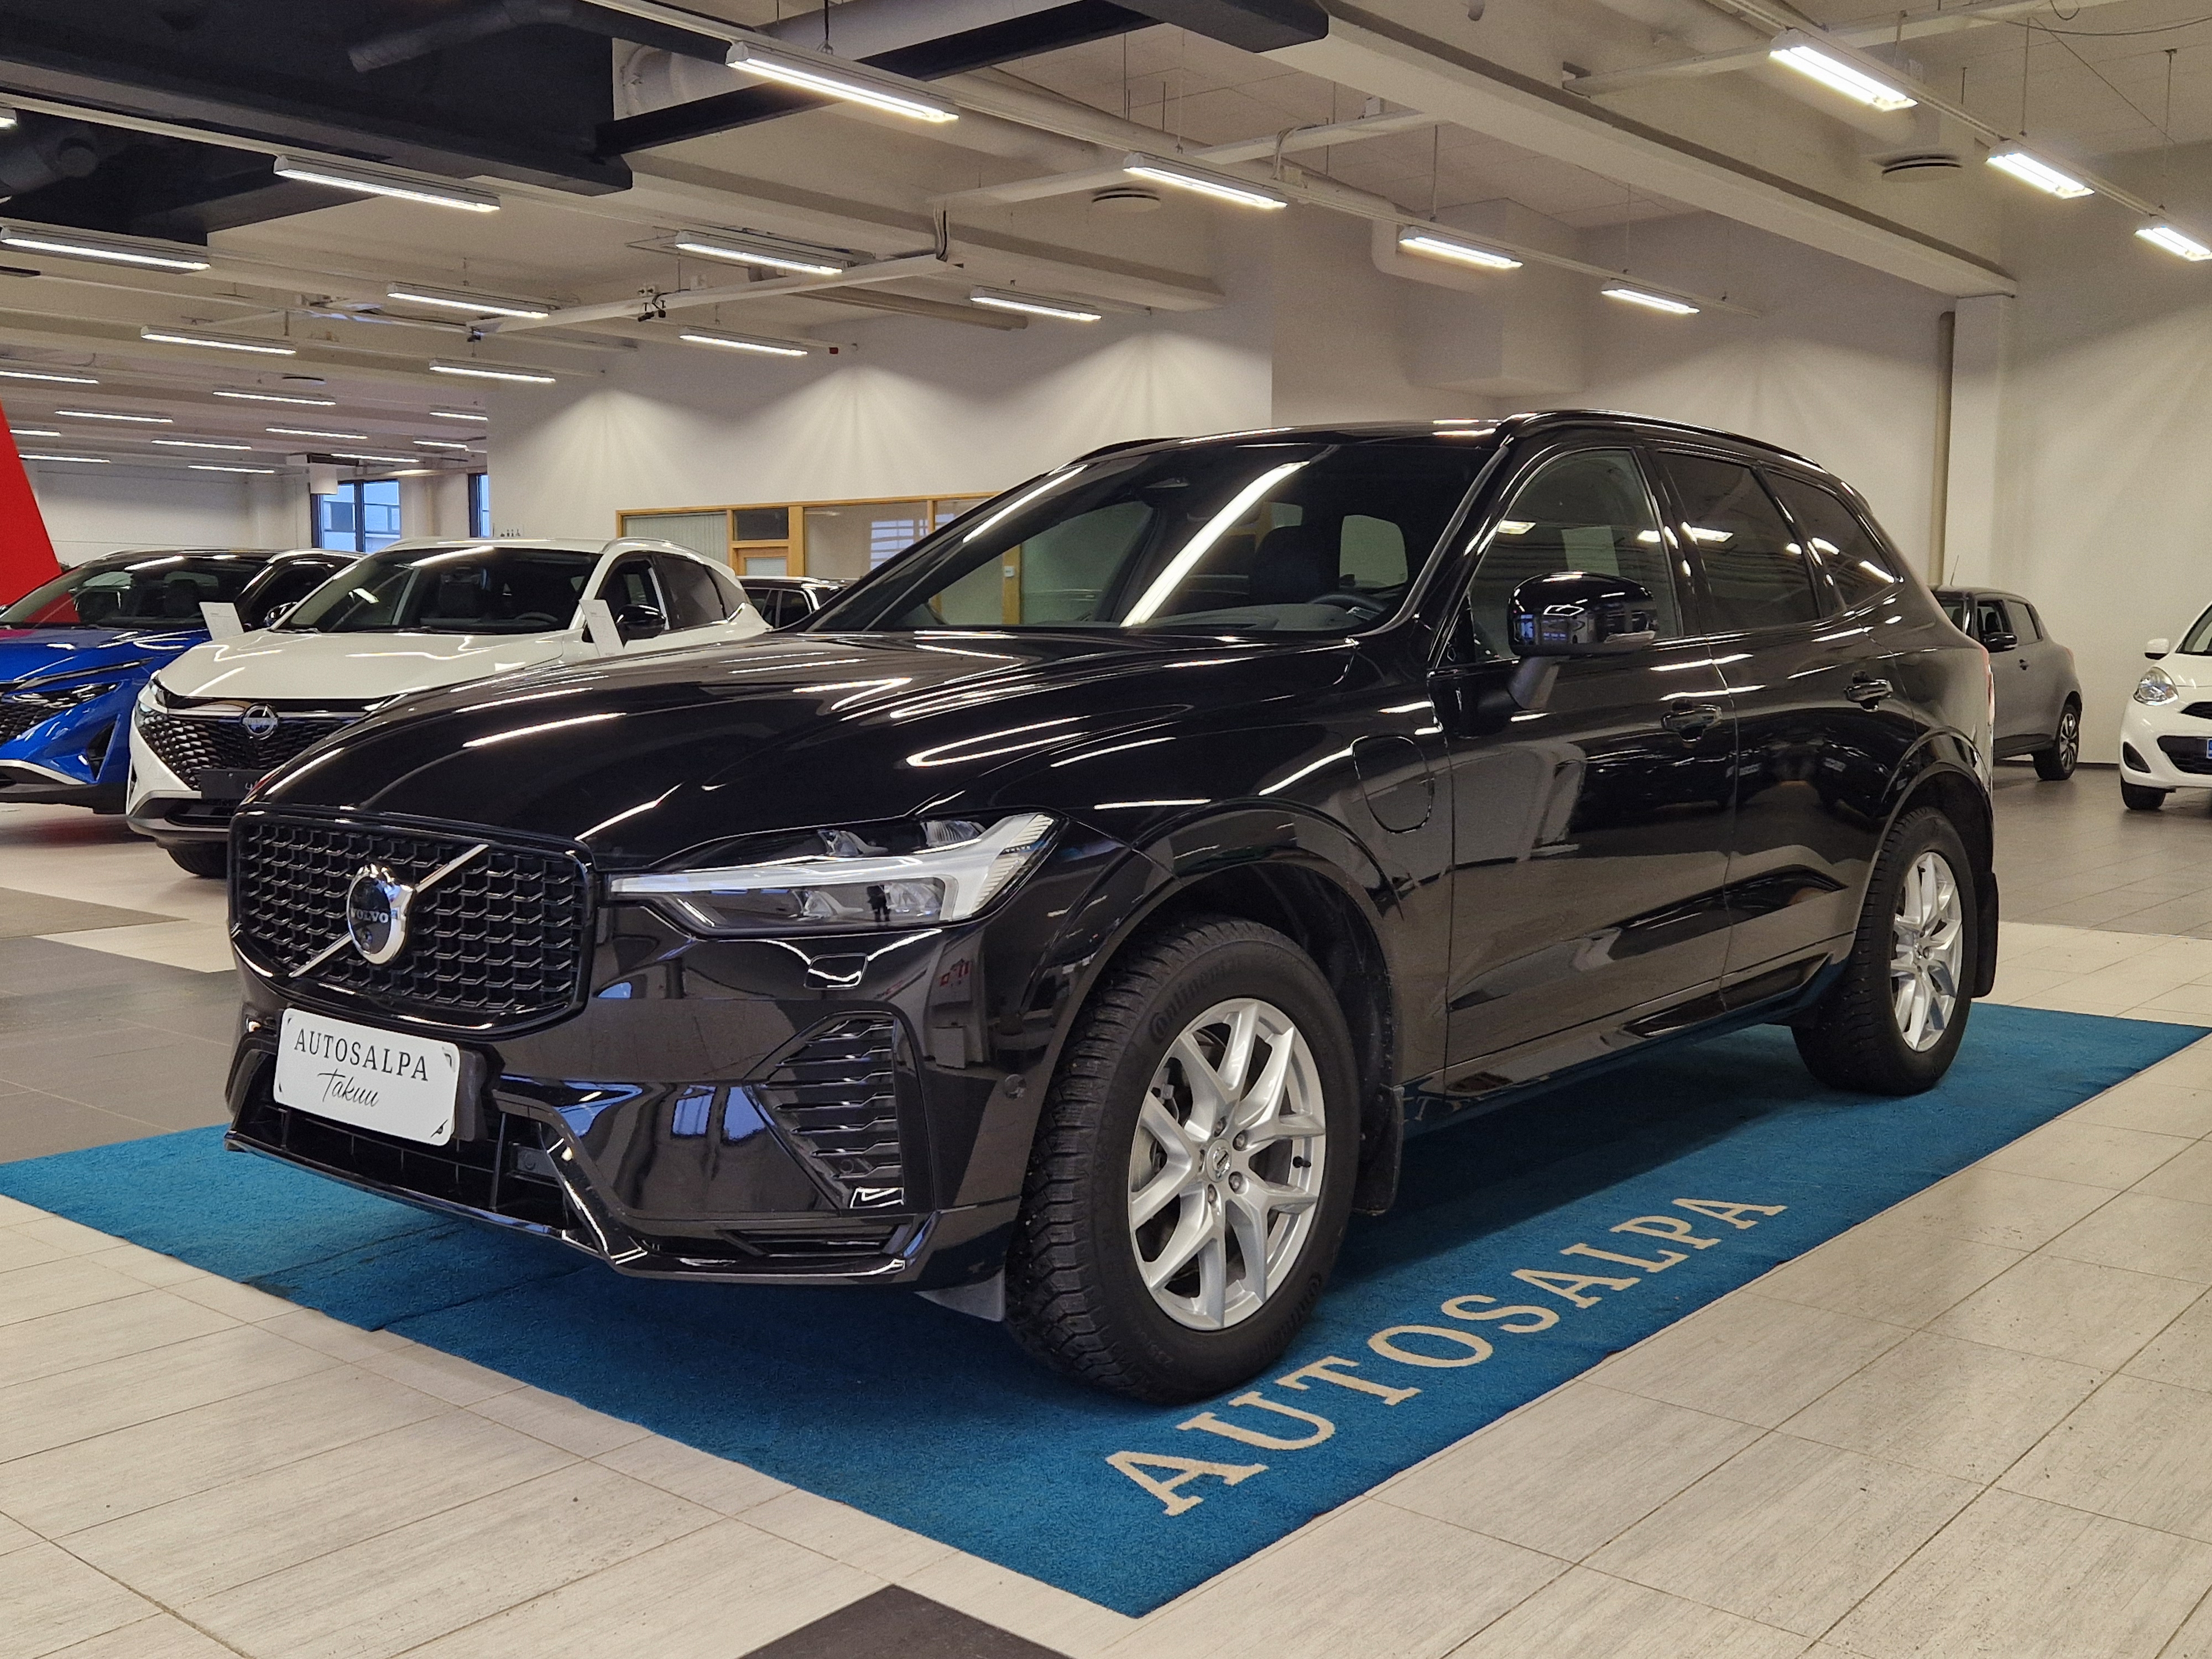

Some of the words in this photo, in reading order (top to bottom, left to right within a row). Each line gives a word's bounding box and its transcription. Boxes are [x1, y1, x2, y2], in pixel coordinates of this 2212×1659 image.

[349, 907, 389, 924] VOLVO
[294, 1027, 429, 1082] AUTOSALPA
[317, 1068, 380, 1107] Takuu
[1107, 1197, 1787, 1516] AUTOSALPA
